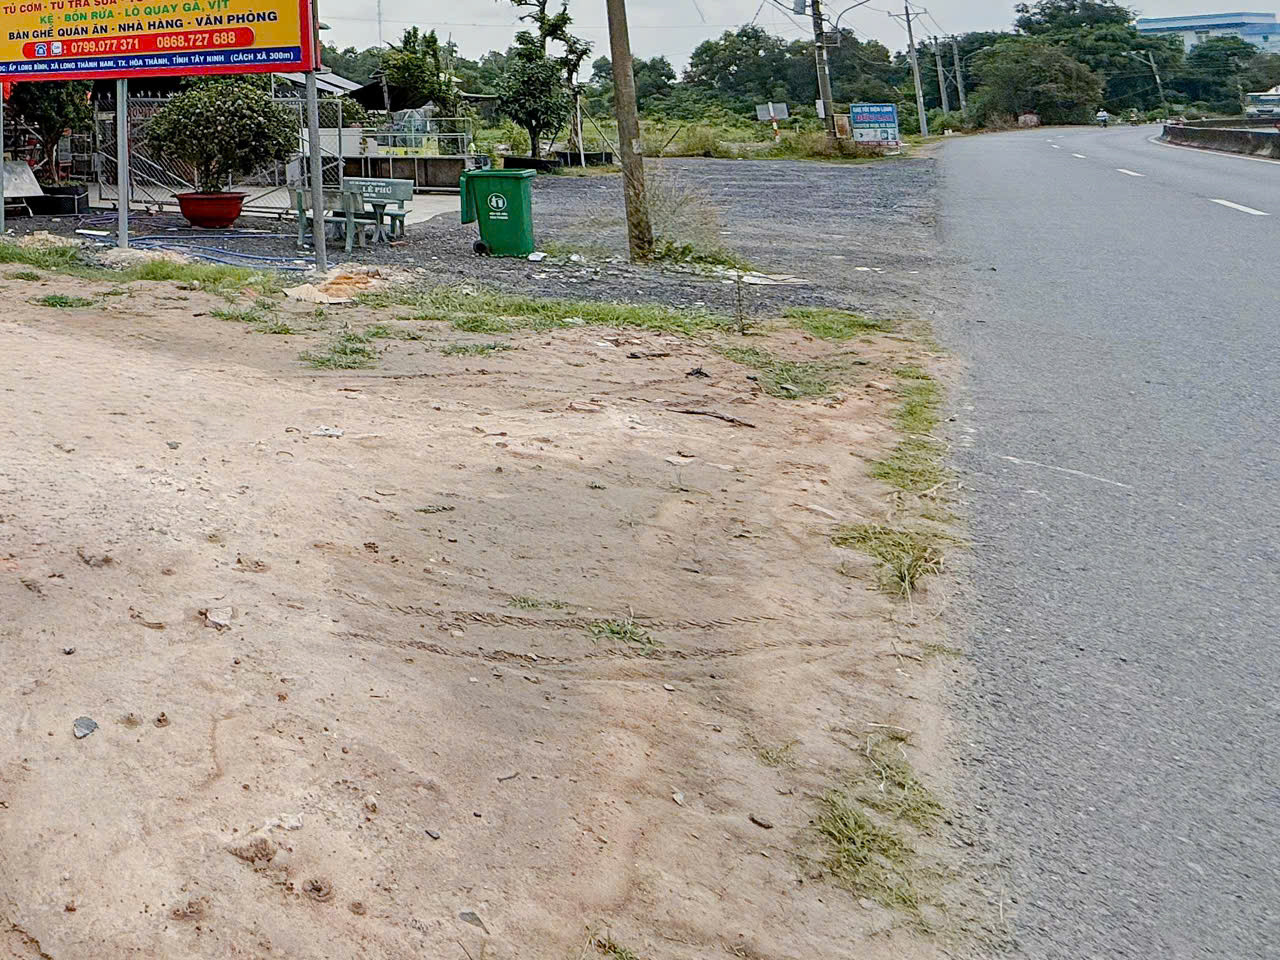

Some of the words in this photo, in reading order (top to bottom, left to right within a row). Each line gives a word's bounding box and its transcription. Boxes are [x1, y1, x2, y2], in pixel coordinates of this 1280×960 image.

[3, 3, 16, 15] TỦ
[20, 3, 42, 13] CƠM
[40, 14, 53, 26] KỆ
[125, 5, 141, 17] LÒ
[144, 4, 178, 16] QUAY
[183, 1, 205, 12] GÀ,
[208, 0, 230, 12] VỊT
[9, 30, 29, 40] BÀN
[33, 25, 54, 38] GHẾ
[58, 25, 88, 37] QUÁN
[92, 24, 108, 34] ĂN
[119, 20, 144, 32] NHÀ
[148, 18, 183, 30] HÀNG
[196, 14, 223, 26] VĂN
[227, 10, 277, 23] PHÒNG
[71, 40, 119, 53] 0799.077
[120, 38, 140, 50] 371
[157, 34, 209, 48] 0868.727
[213, 32, 235, 44] 688
[100, 61, 116, 69] NAM,
[145, 56, 170, 66] THÀNH,
[191, 54, 205, 63] TÂY
[230, 52, 253, 62] (CÁCH
[270, 51, 294, 60] 300m)
